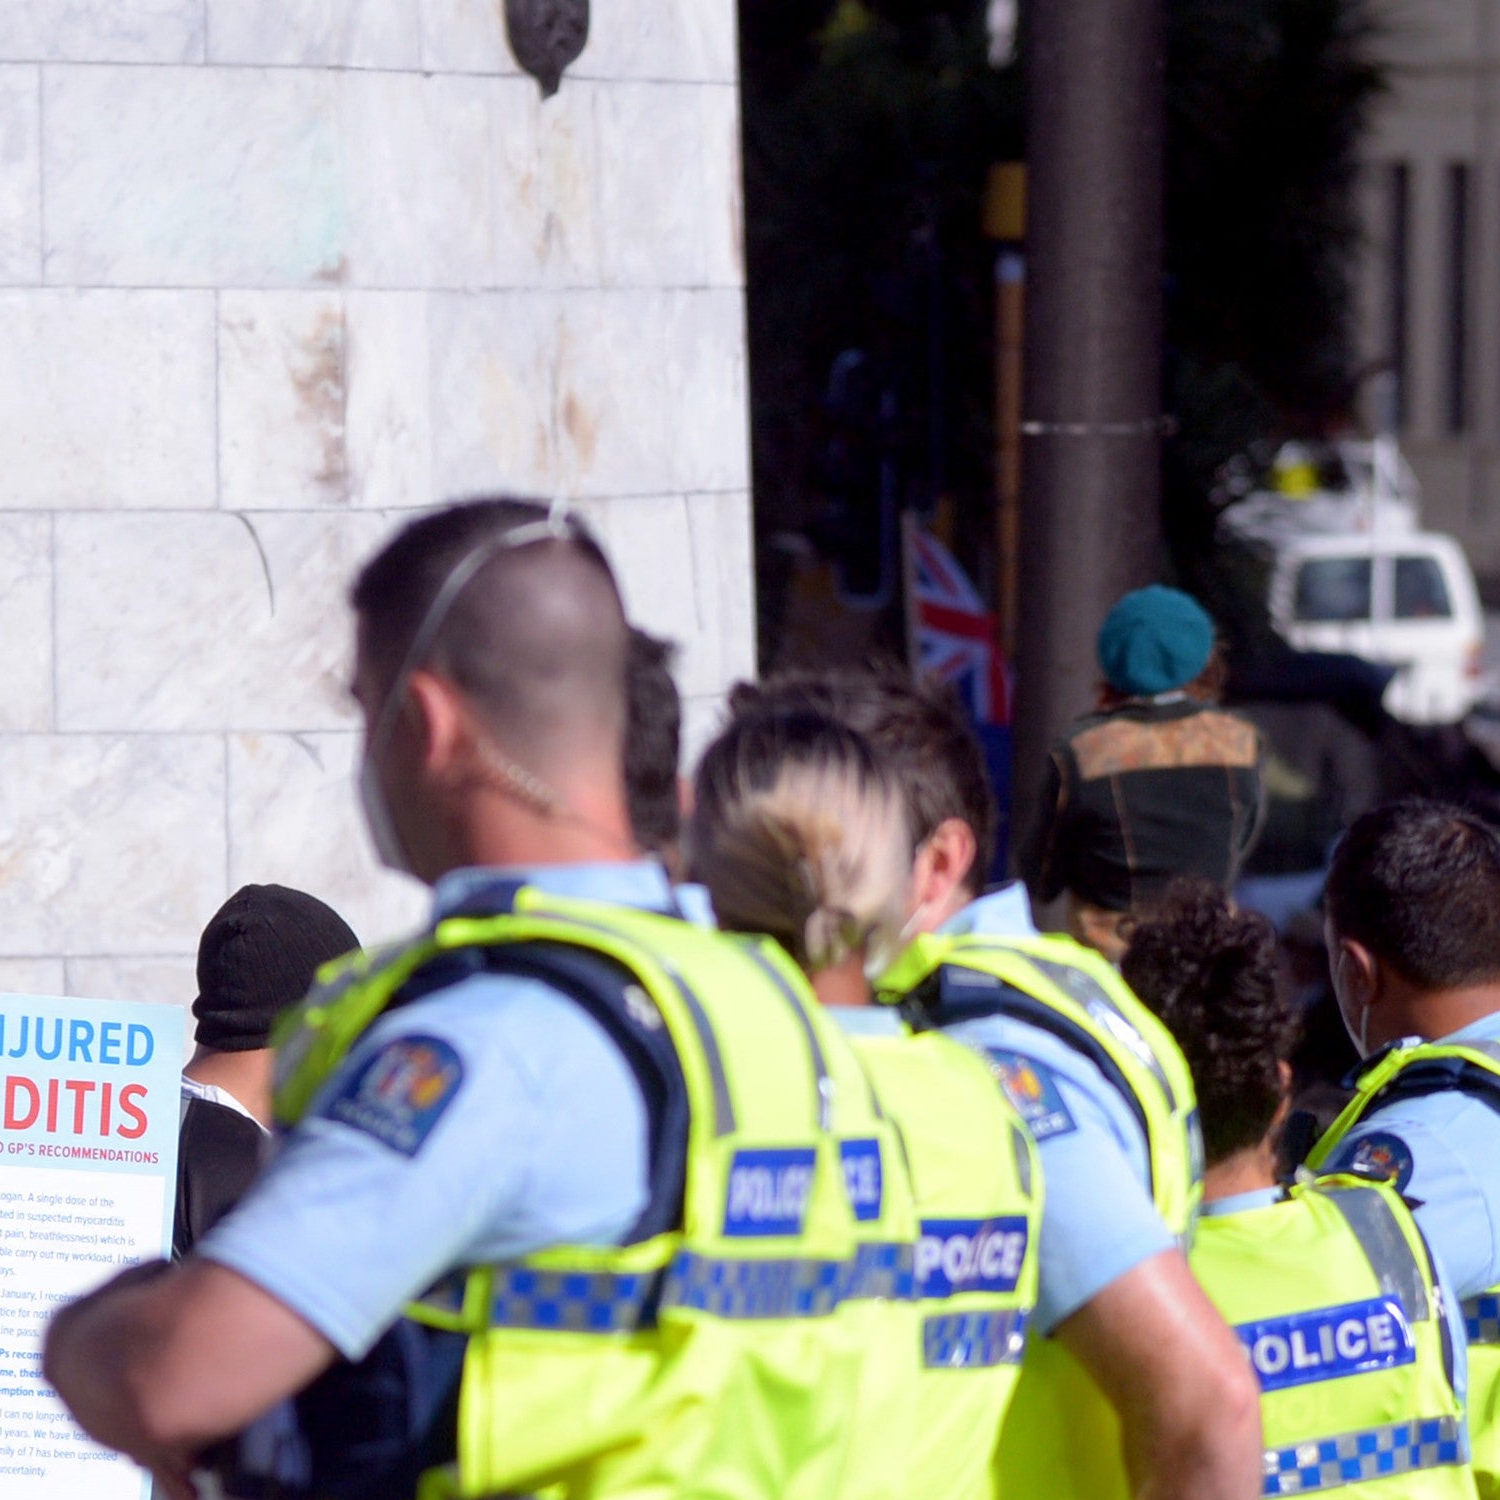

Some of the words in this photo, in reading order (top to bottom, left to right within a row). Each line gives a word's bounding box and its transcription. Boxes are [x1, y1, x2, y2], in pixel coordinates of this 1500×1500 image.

[8, 1143, 35, 1155] GP'S
[39, 1145, 159, 1164] RECOMMENDATIONS
[28, 1193, 34, 1201] A
[37, 1192, 62, 1206] single
[66, 1194, 86, 1206] dose
[90, 1197, 97, 1206] of
[100, 1198, 114, 1208] the
[17, 1211, 24, 1219] in
[28, 1211, 72, 1223] suspected
[75, 1216, 124, 1226] myocarditis
[5, 1228, 26, 1239] pain,
[29, 1230, 98, 1245] breathlessness)
[101, 1235, 125, 1245] which
[128, 1236, 135, 1246] is
[15, 1249, 37, 1261] carry
[40, 1251, 53, 1259] out
[57, 1252, 69, 1262] my
[72, 1252, 115, 1264] workload,
[123, 1255, 140, 1265] had
[0, 1288, 37, 1302] January,
[18, 1308, 30, 1318] for
[33, 1309, 48, 1320] not
[1243, 1312, 1399, 1374] OLICE
[20, 1368, 42, 1378] their
[37, 1389, 56, 1398] was
[4, 1411, 19, 1419] can
[22, 1412, 33, 1420] no
[36, 1410, 65, 1423] longer
[34, 1429, 46, 1438] We
[50, 1430, 70, 1440] have
[18, 1447, 26, 1456] of
[30, 1447, 34, 1456] 7
[36, 1448, 51, 1458] has
[54, 1450, 75, 1459] been
[78, 1451, 117, 1463] uprooted
